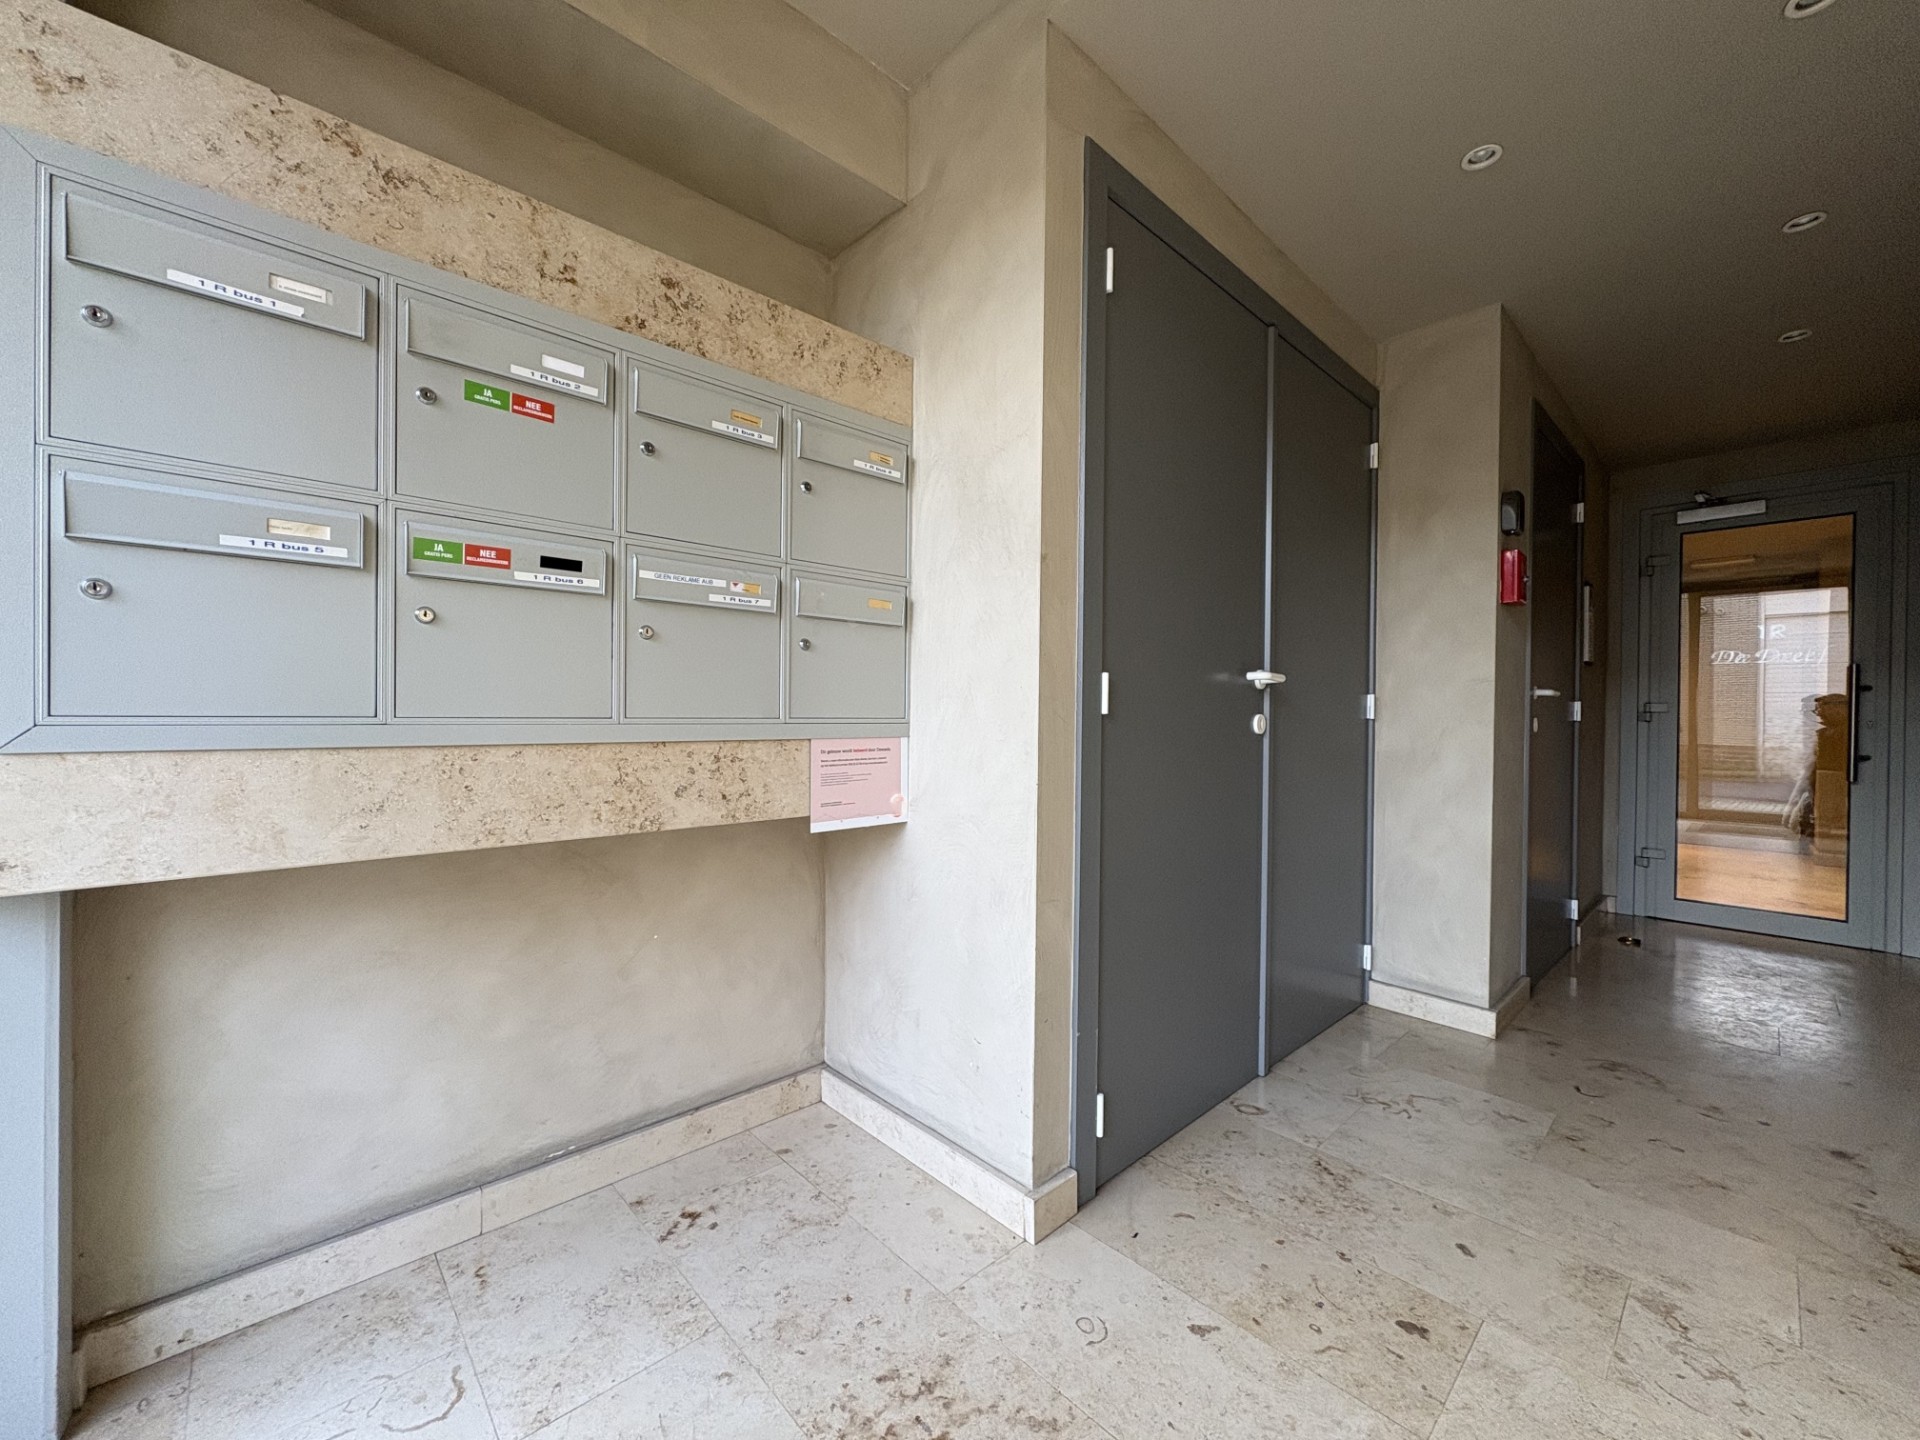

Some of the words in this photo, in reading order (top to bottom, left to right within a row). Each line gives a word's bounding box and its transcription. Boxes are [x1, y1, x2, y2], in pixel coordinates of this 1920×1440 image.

[214, 284, 228, 293] R
[233, 289, 263, 304] bus
[270, 299, 276, 307] 1
[552, 377, 571, 388] bus
[525, 400, 542, 411] NEE
[741, 429, 755, 437] bus
[281, 542, 309, 552] bus
[479, 549, 497, 558] NEE
[554, 576, 574, 584] bus
[576, 577, 584, 585] 6
[653, 572, 672, 580] GEEN
[672, 574, 701, 584] REKLAME
[701, 578, 714, 586] AUB
